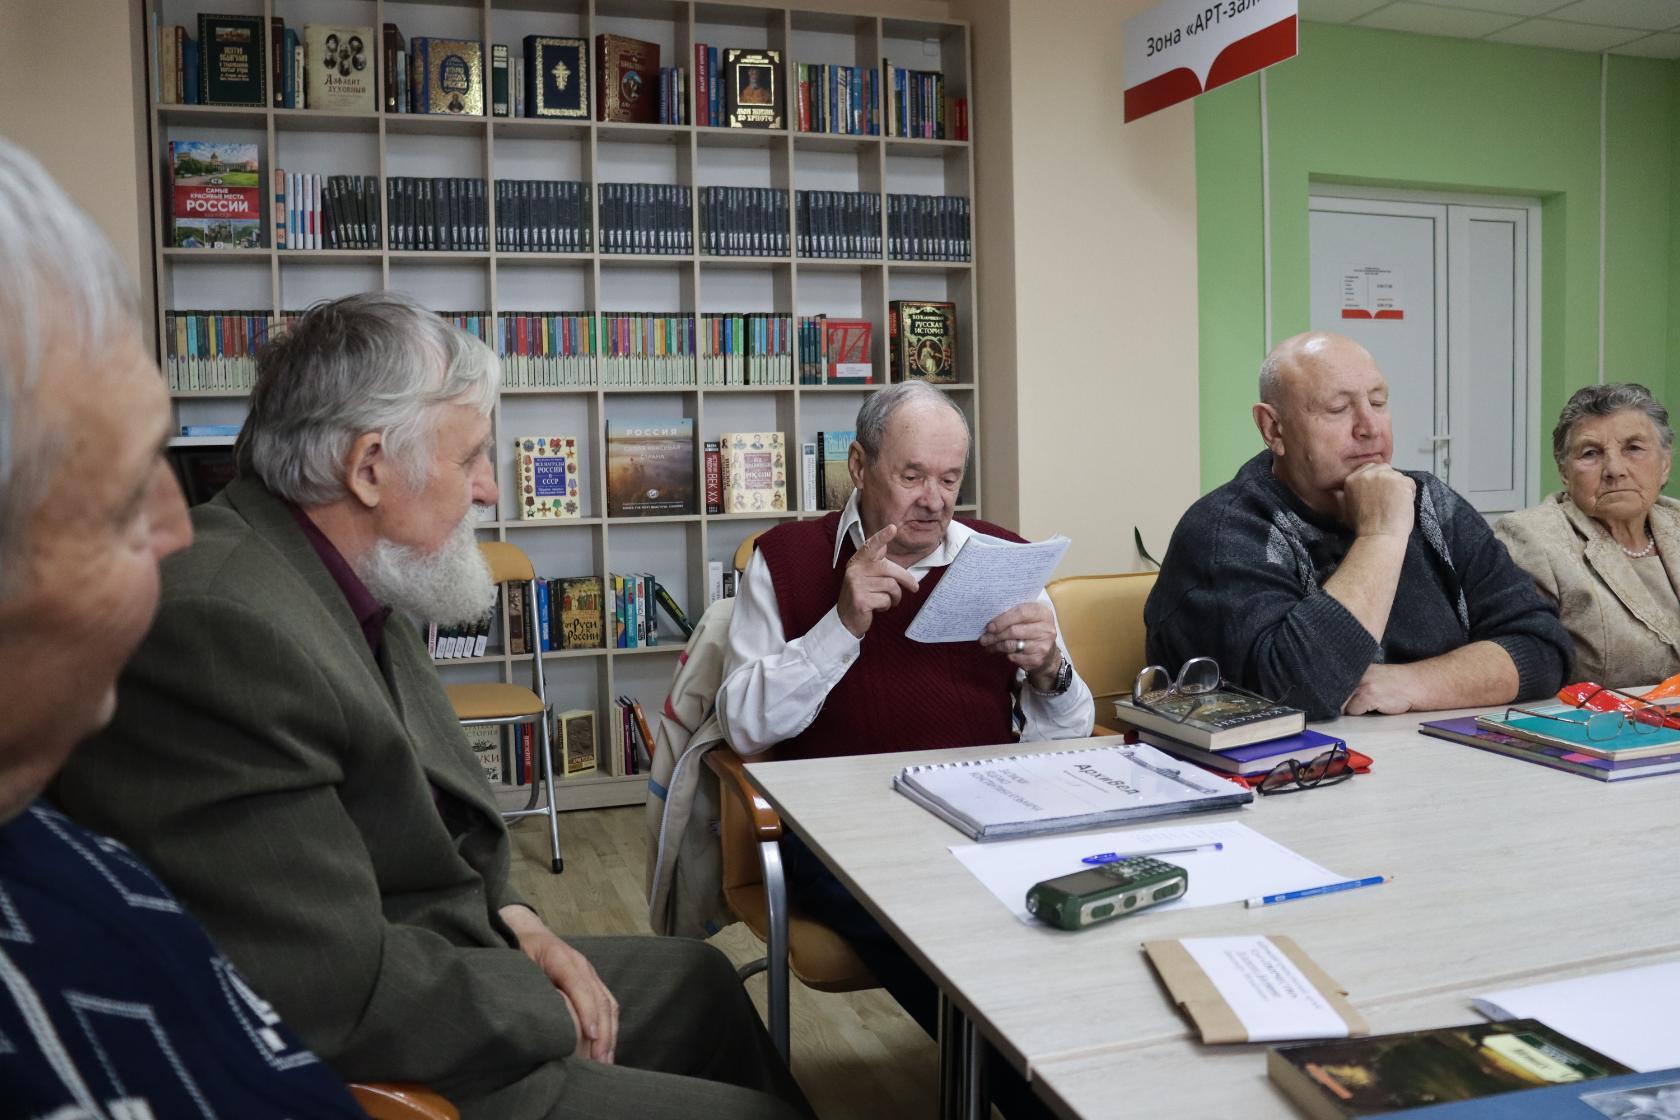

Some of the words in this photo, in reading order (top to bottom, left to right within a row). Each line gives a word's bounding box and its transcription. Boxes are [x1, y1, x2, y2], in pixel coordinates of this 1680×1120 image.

[1146, 28, 1181, 57] Зона
[186, 200, 248, 212] РОССИИ
[626, 428, 677, 436] РОССИЯ
[707, 473, 718, 489] ВЕК
[707, 491, 718, 503] XX
[567, 630, 599, 645] России
